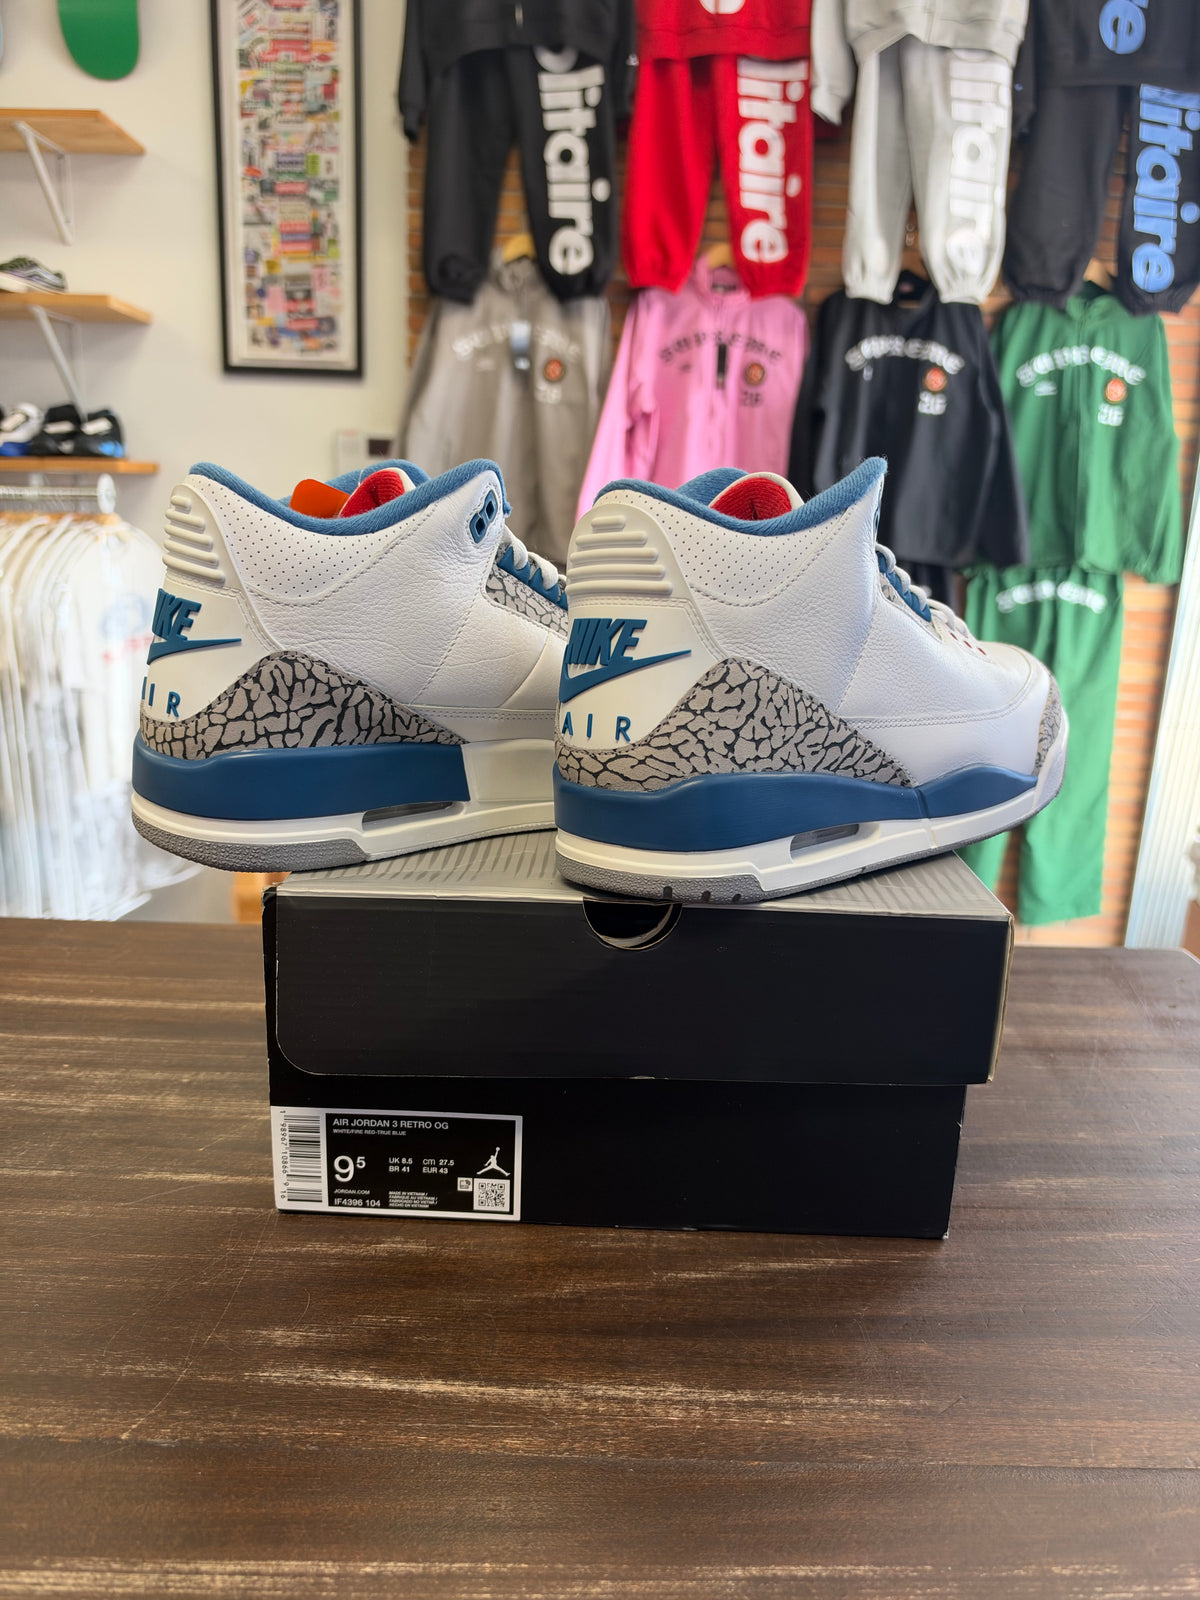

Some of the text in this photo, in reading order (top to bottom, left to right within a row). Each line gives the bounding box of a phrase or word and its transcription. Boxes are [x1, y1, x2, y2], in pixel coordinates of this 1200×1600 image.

[566, 618, 647, 666] NIKE
[561, 711, 631, 742] AIR
[280, 1123, 288, 1147] 98967
[333, 1118, 349, 1126] AIR
[351, 1119, 389, 1127] JORDAN
[400, 1121, 432, 1129] RETRO
[434, 1122, 449, 1130] OG
[281, 1151, 289, 1174] 10866
[334, 1198, 380, 1207] IF4396 104
